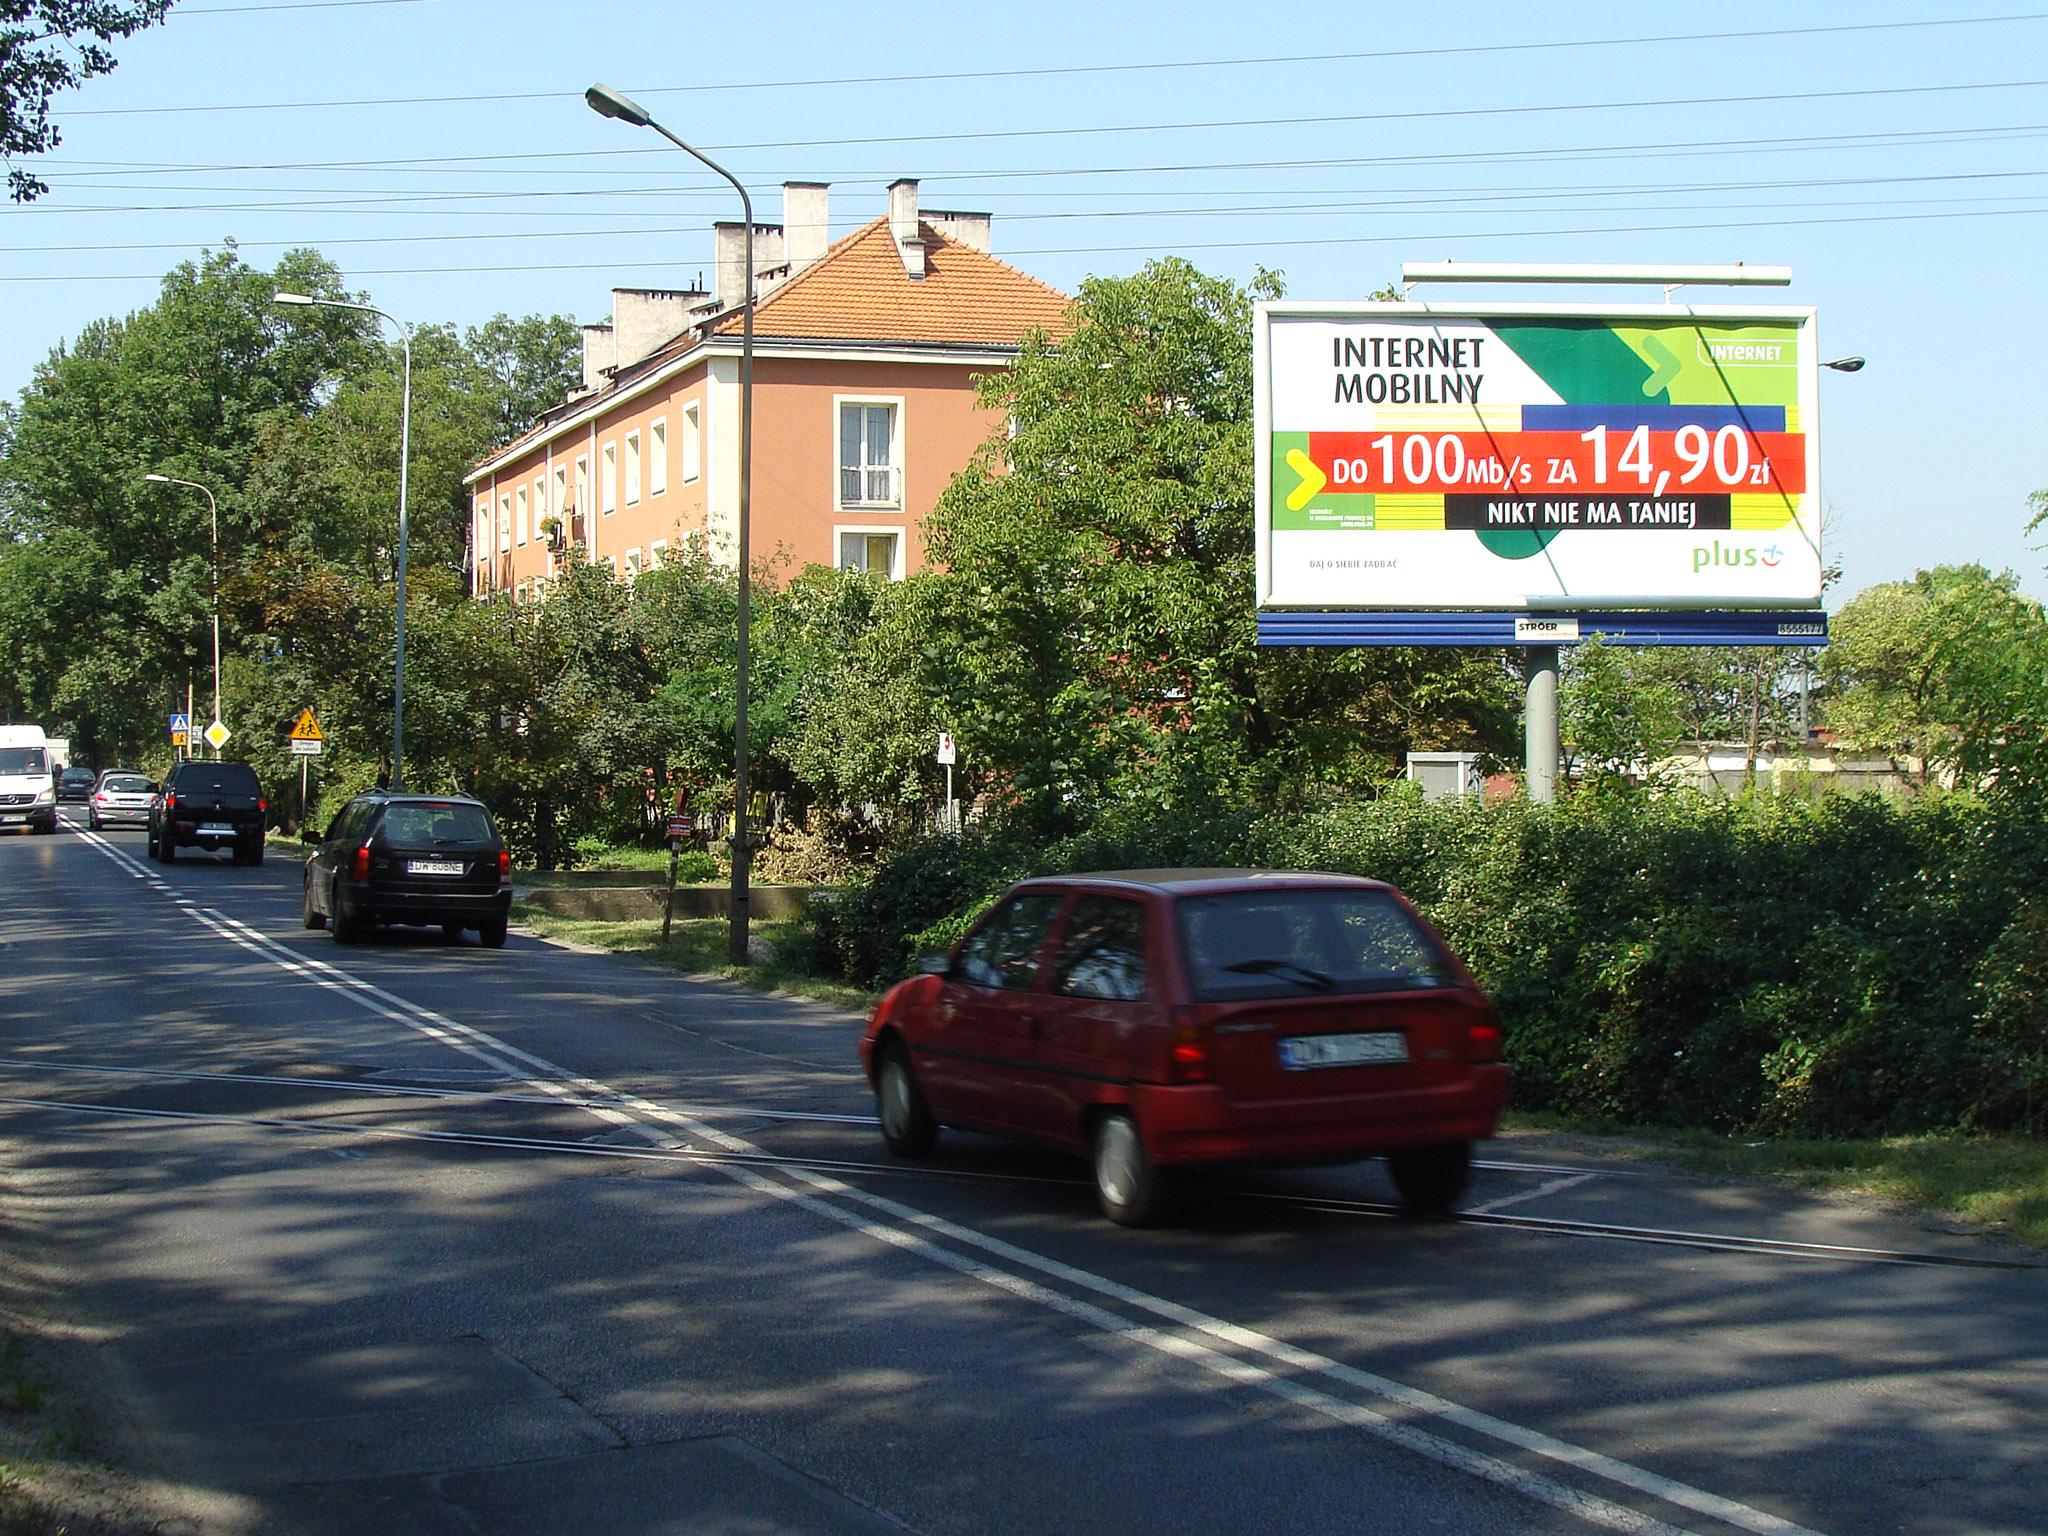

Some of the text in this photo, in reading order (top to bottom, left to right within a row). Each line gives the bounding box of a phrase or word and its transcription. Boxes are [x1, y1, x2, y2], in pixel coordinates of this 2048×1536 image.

[1333, 337, 1485, 368] INTERNET
[1334, 373, 1485, 404] MOBILNY
[1333, 458, 1369, 484] DO
[1546, 458, 1578, 485] ZA
[1487, 501, 1697, 529] NIKT NIE MA TANIEJ
[1692, 540, 1758, 573] plus
